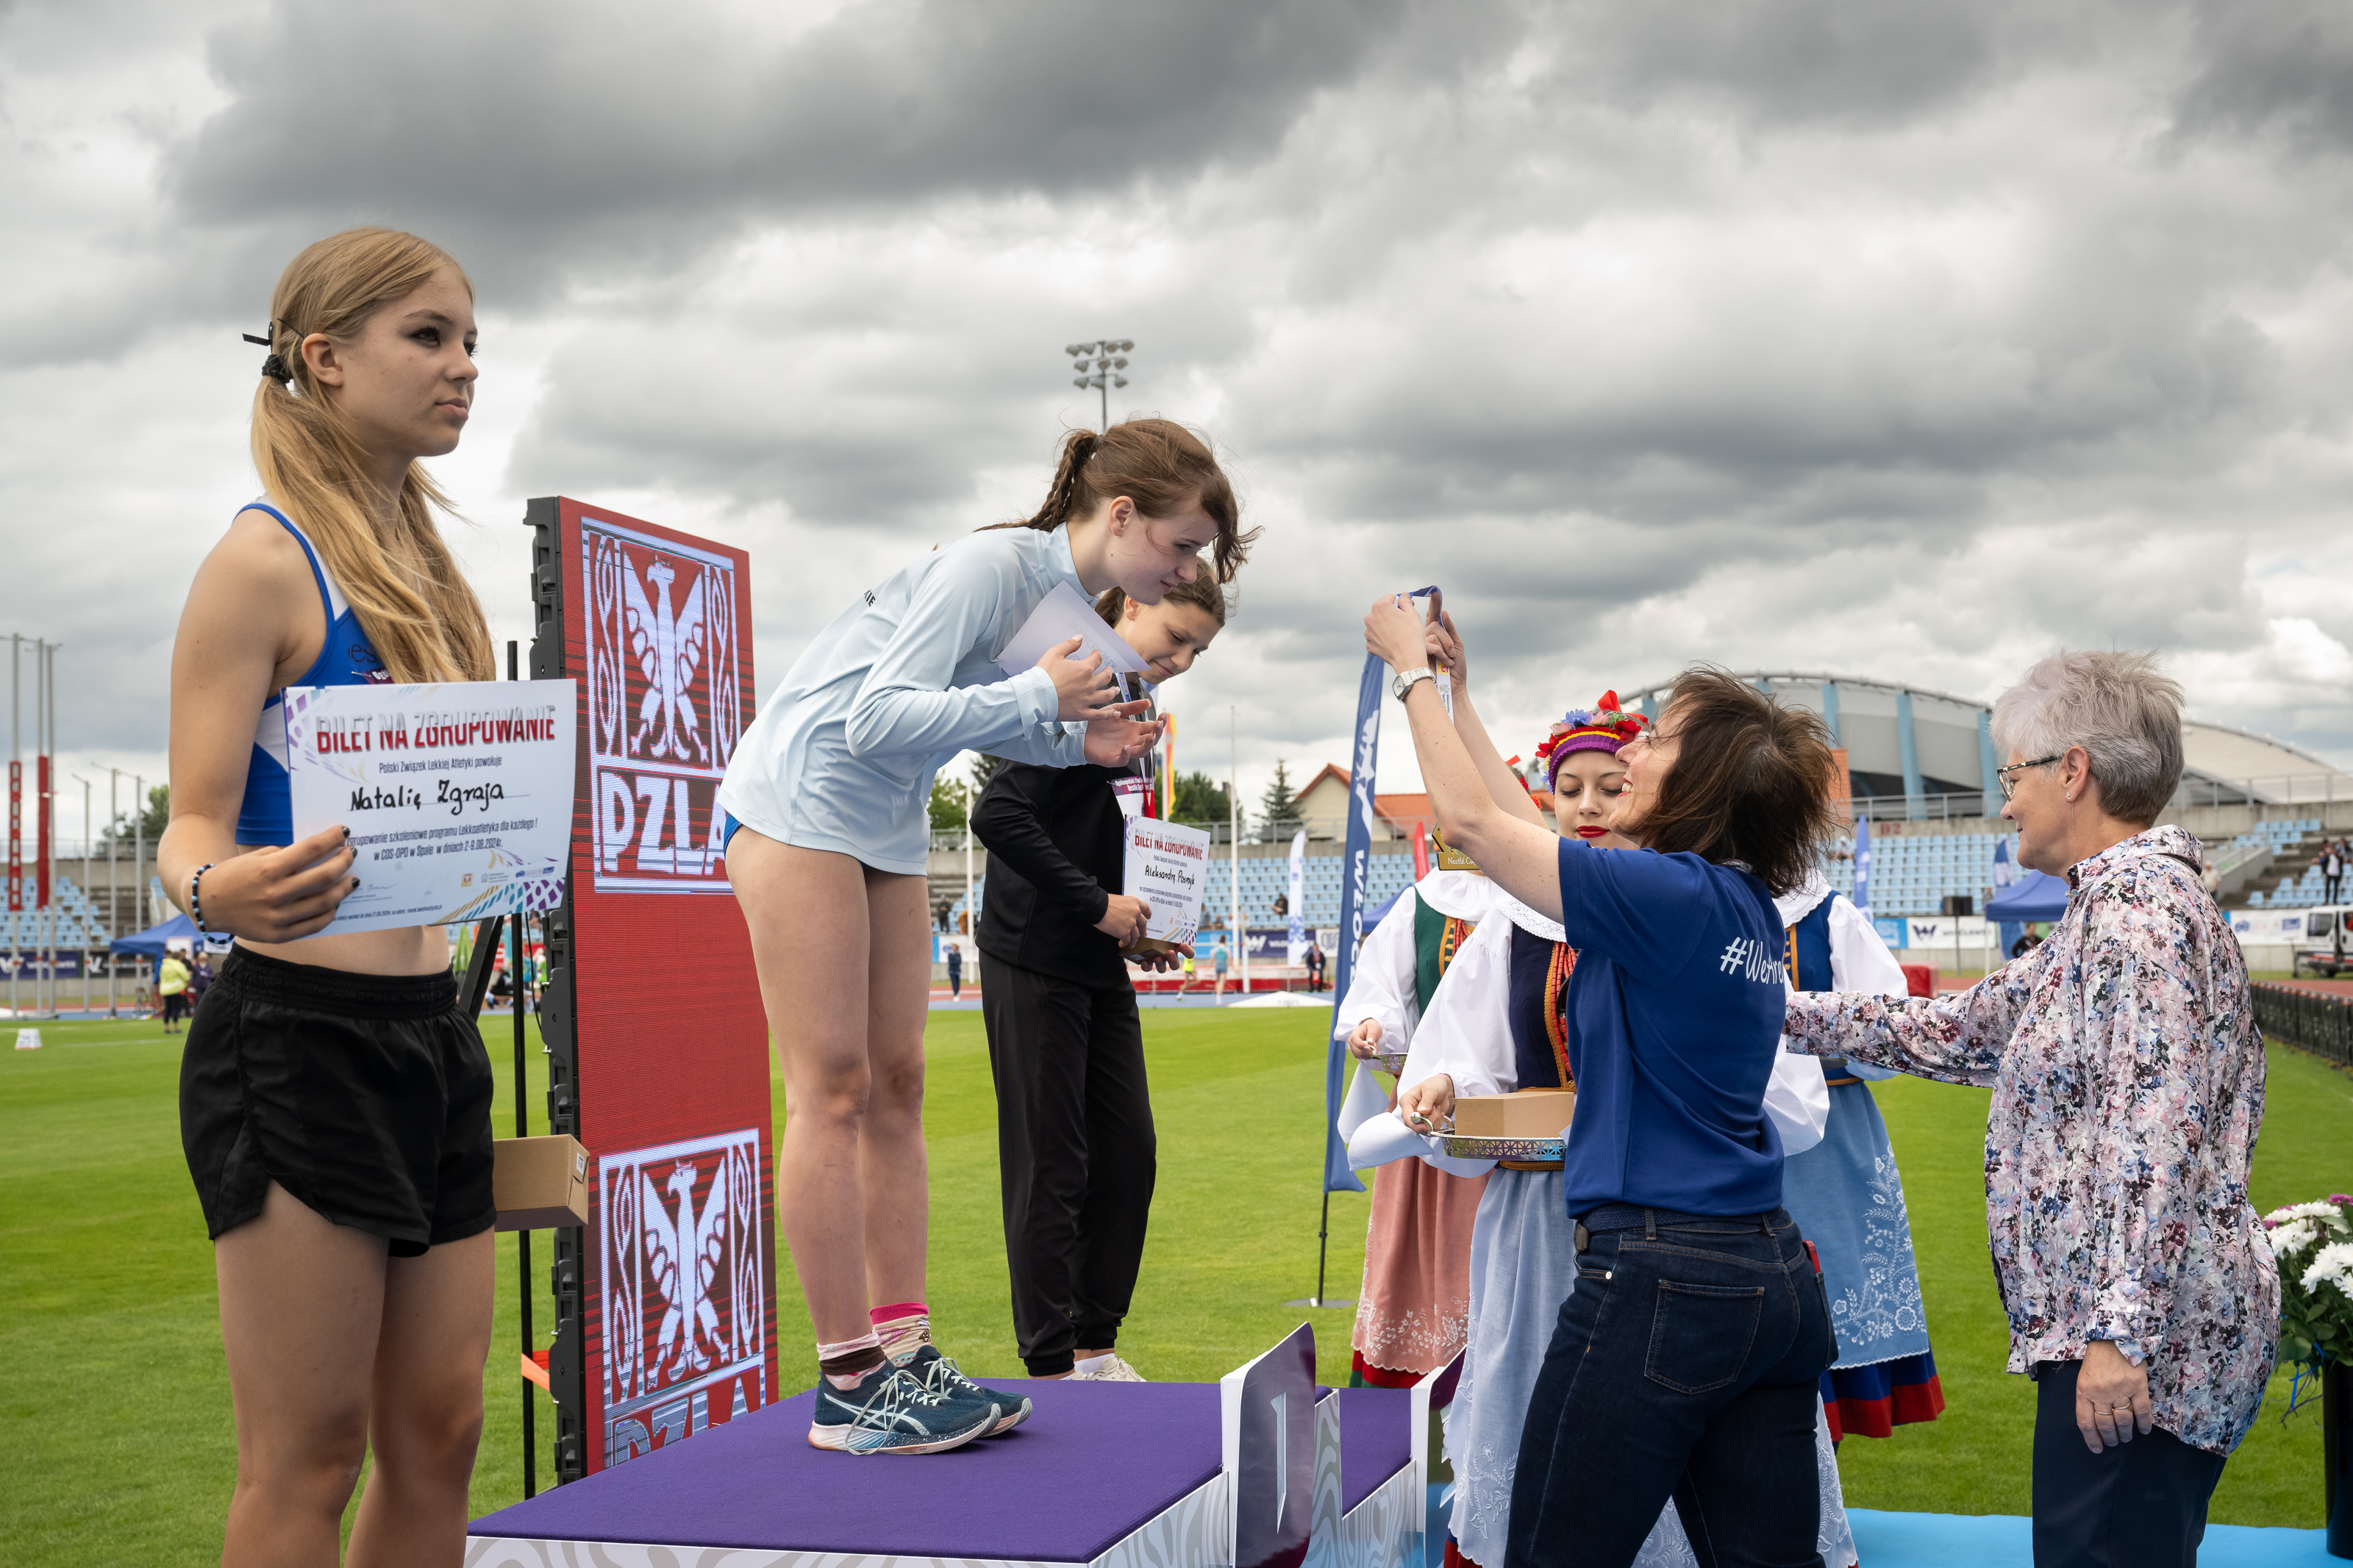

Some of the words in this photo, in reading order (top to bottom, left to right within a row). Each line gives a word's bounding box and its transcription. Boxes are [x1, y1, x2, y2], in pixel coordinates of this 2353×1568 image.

[316, 713, 372, 753] BILET
[379, 712, 408, 750] NA
[414, 705, 556, 748] ZGRUPOWANIE
[379, 762, 399, 773] Polski
[400, 760, 426, 773] Związek
[427, 759, 450, 772] Lekkiej
[451, 757, 474, 770] Atletyki
[474, 756, 502, 769] powołuje
[346, 834, 388, 848] zgrupowanie
[389, 828, 427, 843] szkoleniowe
[429, 826, 457, 840] programu
[458, 820, 499, 837] Lekkoatletyka
[500, 820, 510, 831] dla
[510, 817, 534, 831] każdego
[1135, 828, 1154, 849] BILET
[1154, 831, 1163, 851] NA
[1165, 834, 1204, 860] ZGRUPOWANIE
[374, 851, 380, 861] w
[409, 846, 415, 857] w
[416, 843, 434, 858] Spale
[436, 844, 442, 855] w
[443, 841, 463, 853] dniach
[1721, 937, 1783, 984] #WeAre
